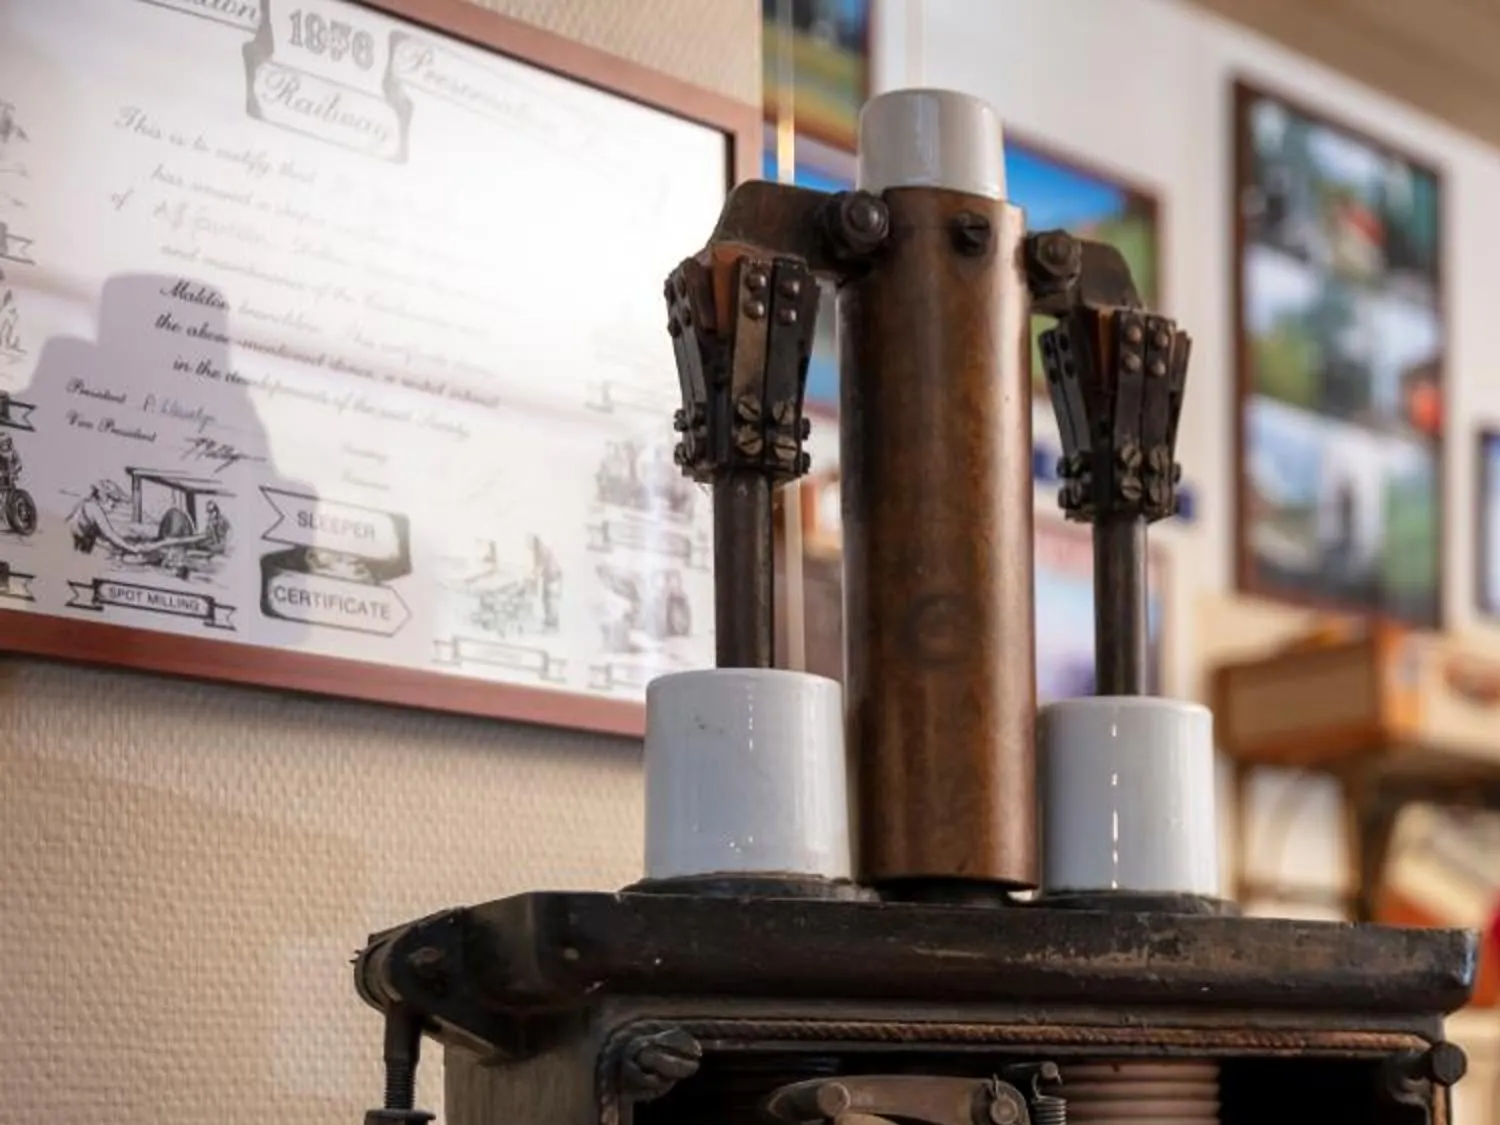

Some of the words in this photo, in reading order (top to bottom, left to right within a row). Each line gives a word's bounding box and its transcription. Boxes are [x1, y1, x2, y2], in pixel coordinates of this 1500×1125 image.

[262, 66, 388, 142] Railway
[113, 105, 162, 139] This
[110, 186, 135, 211] of
[159, 279, 230, 310] Maldon
[154, 312, 182, 332] the
[172, 355, 191, 372] in
[196, 358, 222, 379] the
[65, 376, 127, 405] President
[97, 416, 157, 443] President
[296, 510, 376, 539] SLEEPER
[108, 586, 143, 602] SPOT
[146, 592, 200, 612] MILLING
[273, 584, 392, 620] CERTIFICATE
